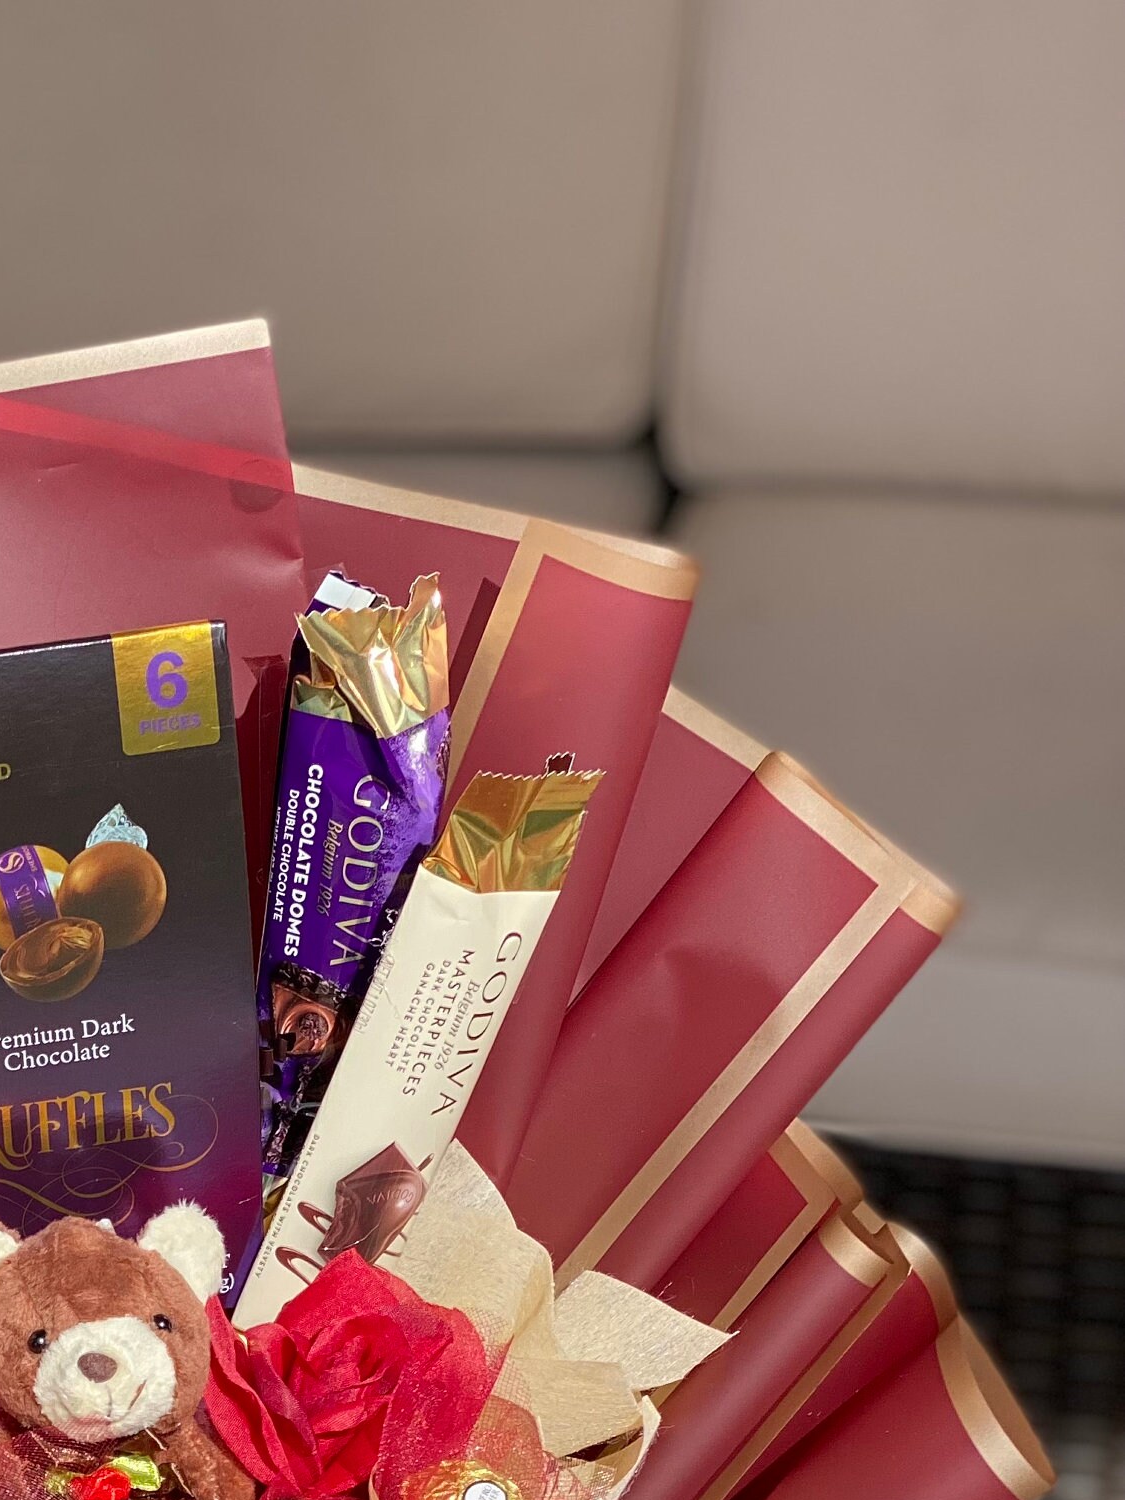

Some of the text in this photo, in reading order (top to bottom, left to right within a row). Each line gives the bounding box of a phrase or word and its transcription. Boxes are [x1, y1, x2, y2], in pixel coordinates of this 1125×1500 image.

[139, 713, 202, 736] PIECES
[145, 651, 189, 709] 6
[283, 789, 300, 843] DOUBLE
[284, 764, 324, 957] CHOCOLATE DOMES
[273, 844, 292, 922] CHOCOLATE
[316, 818, 344, 917] Belgium 1926
[329, 774, 391, 967] GODIVA
[4, 1043, 111, 1072] Chocolate
[81, 1013, 135, 1040] Dark
[385, 962, 435, 1067] GANACHE HEART
[396, 959, 452, 1073] DARK CHOCOLATE
[402, 949, 475, 1096] MASTERPIECES
[430, 932, 523, 1116] GODIVA
[434, 978, 482, 1071] Belgium 1926
[305, 1133, 320, 1157] DARK
